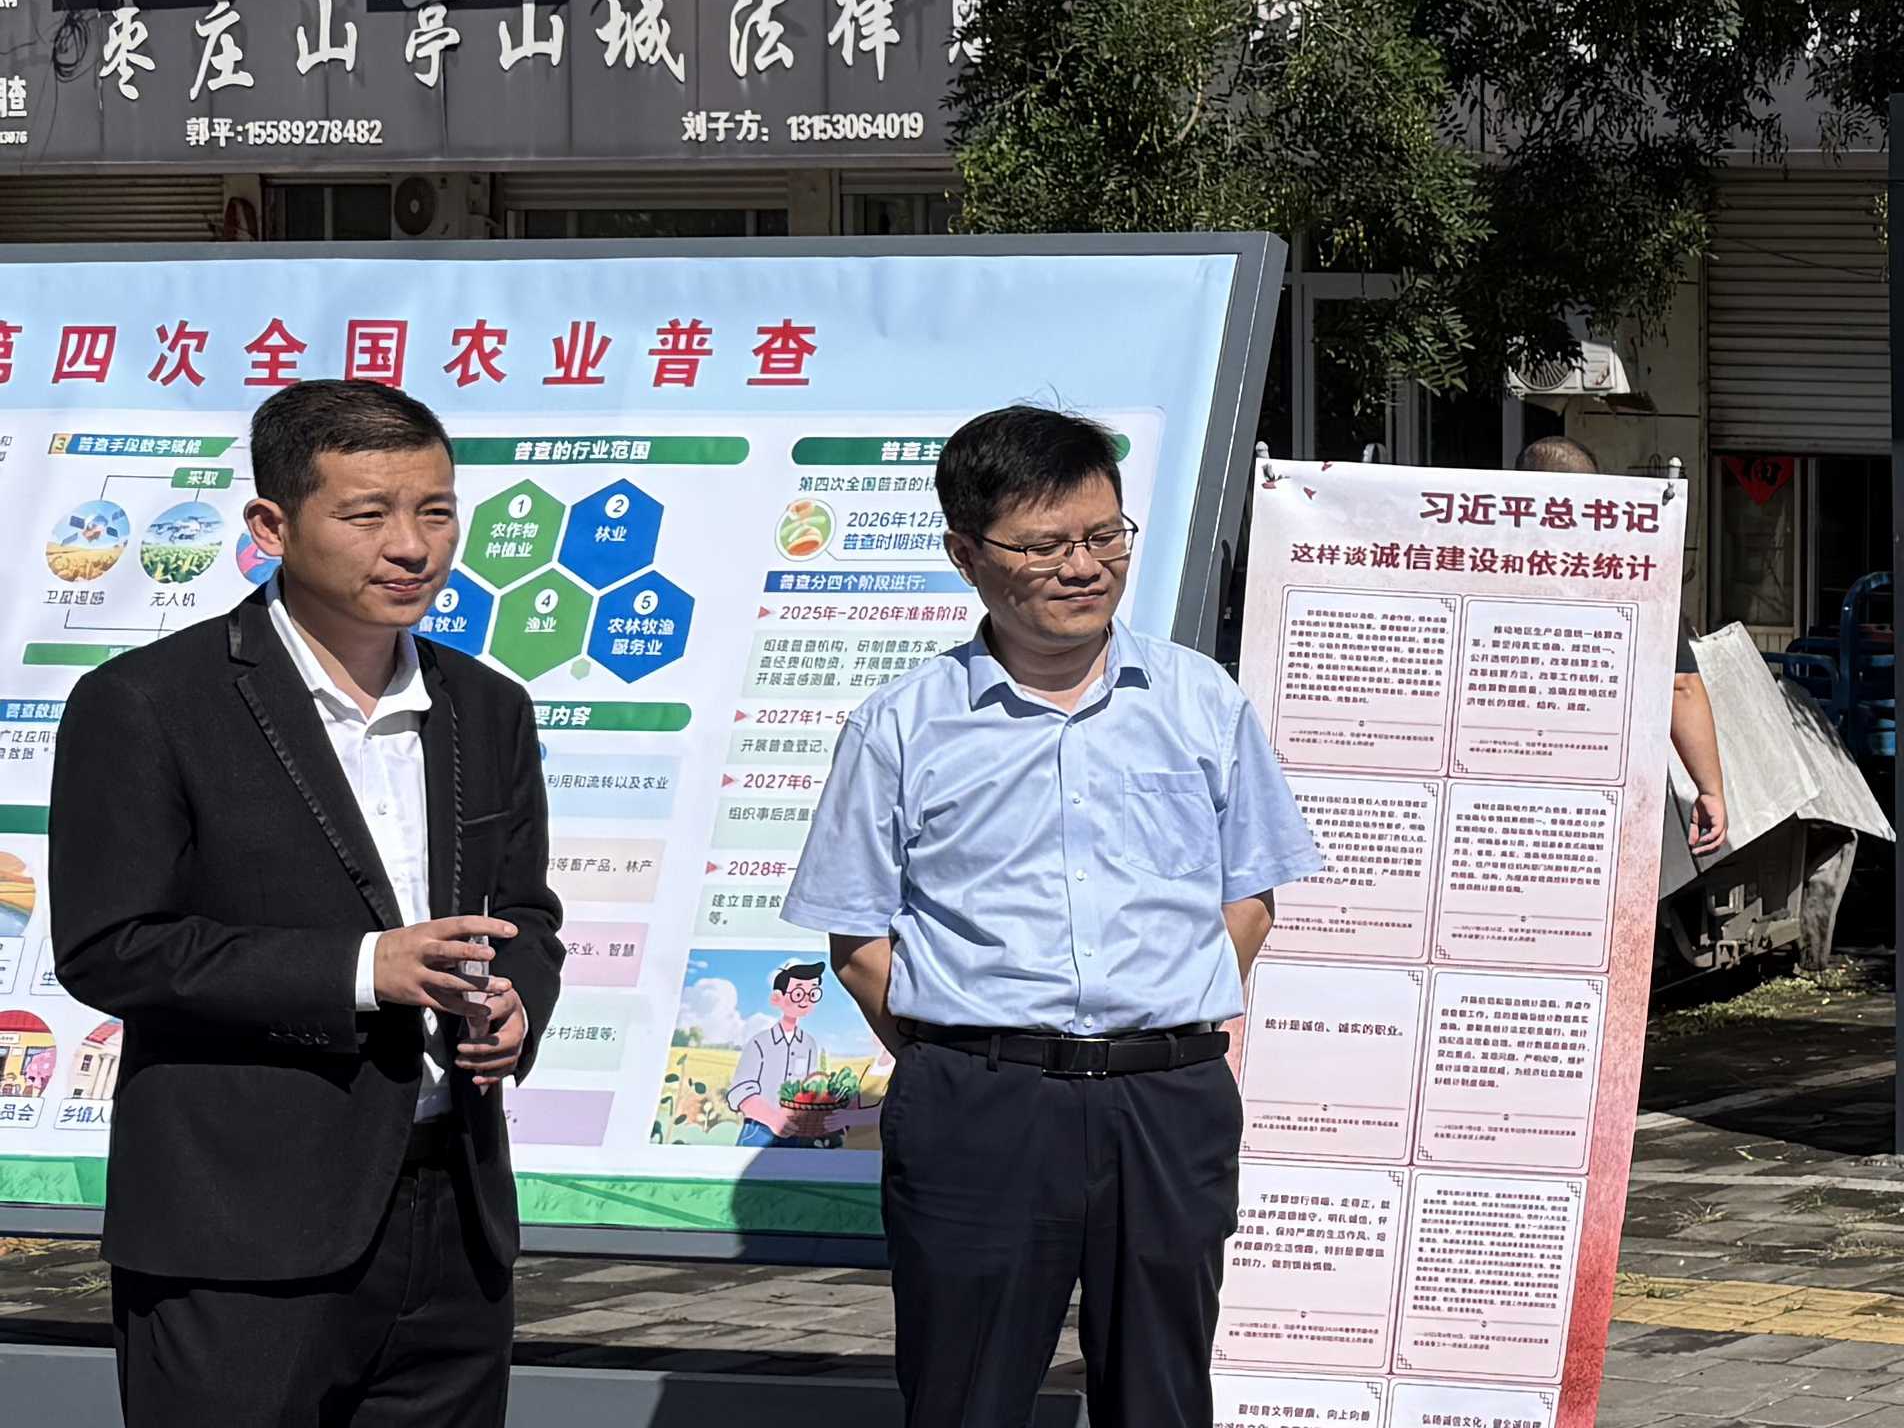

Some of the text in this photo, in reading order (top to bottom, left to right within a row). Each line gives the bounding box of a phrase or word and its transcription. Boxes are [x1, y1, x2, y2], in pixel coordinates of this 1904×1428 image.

[185, 115, 384, 149] 郭平:15589278482
[513, 440, 651, 462] 普查的行业范围
[612, 499, 625, 514] 2
[1419, 490, 1661, 535] 习近平总书记
[490, 521, 539, 539] 农作物
[594, 525, 628, 543] 林业
[485, 541, 534, 559] 种植业
[1289, 541, 1657, 582] 这样谈诚信建设和依法统计
[149, 591, 196, 607] 无人机
[442, 593, 453, 607] 3
[540, 594, 552, 608] 4
[640, 594, 653, 609] 5
[523, 616, 557, 634] 渔业
[606, 617, 675, 635] 农林牧渔
[610, 638, 664, 657] 服务业
[755, 709, 852, 726] 2027年1-5
[1264, 1018, 1405, 1037] 统计是诚信、诚实的职业。
